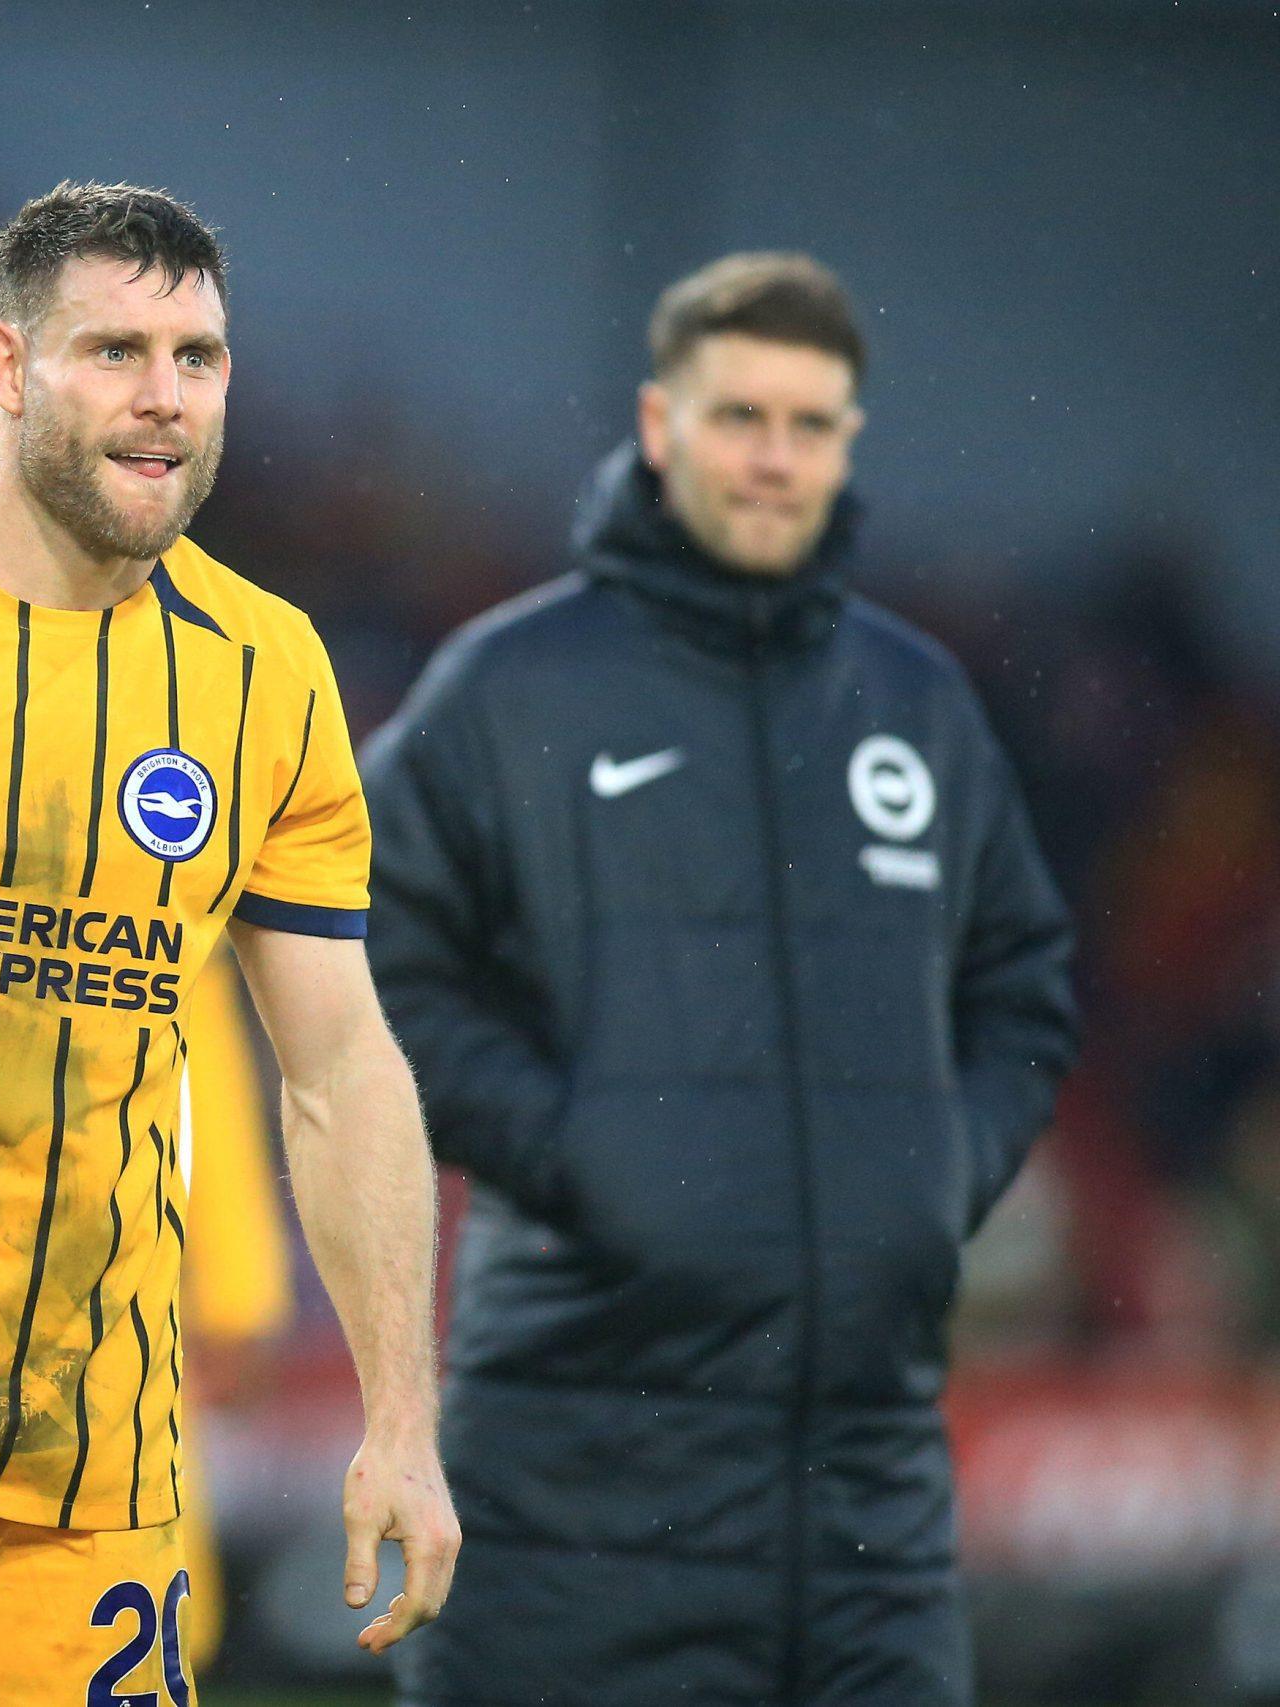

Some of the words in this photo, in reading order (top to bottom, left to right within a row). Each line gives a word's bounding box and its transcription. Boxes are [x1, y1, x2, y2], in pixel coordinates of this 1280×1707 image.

[137, 757, 178, 778] BRIGHTON
[181, 762, 188, 770] &
[191, 768, 208, 792] HOVE
[150, 839, 184, 852] ALBION
